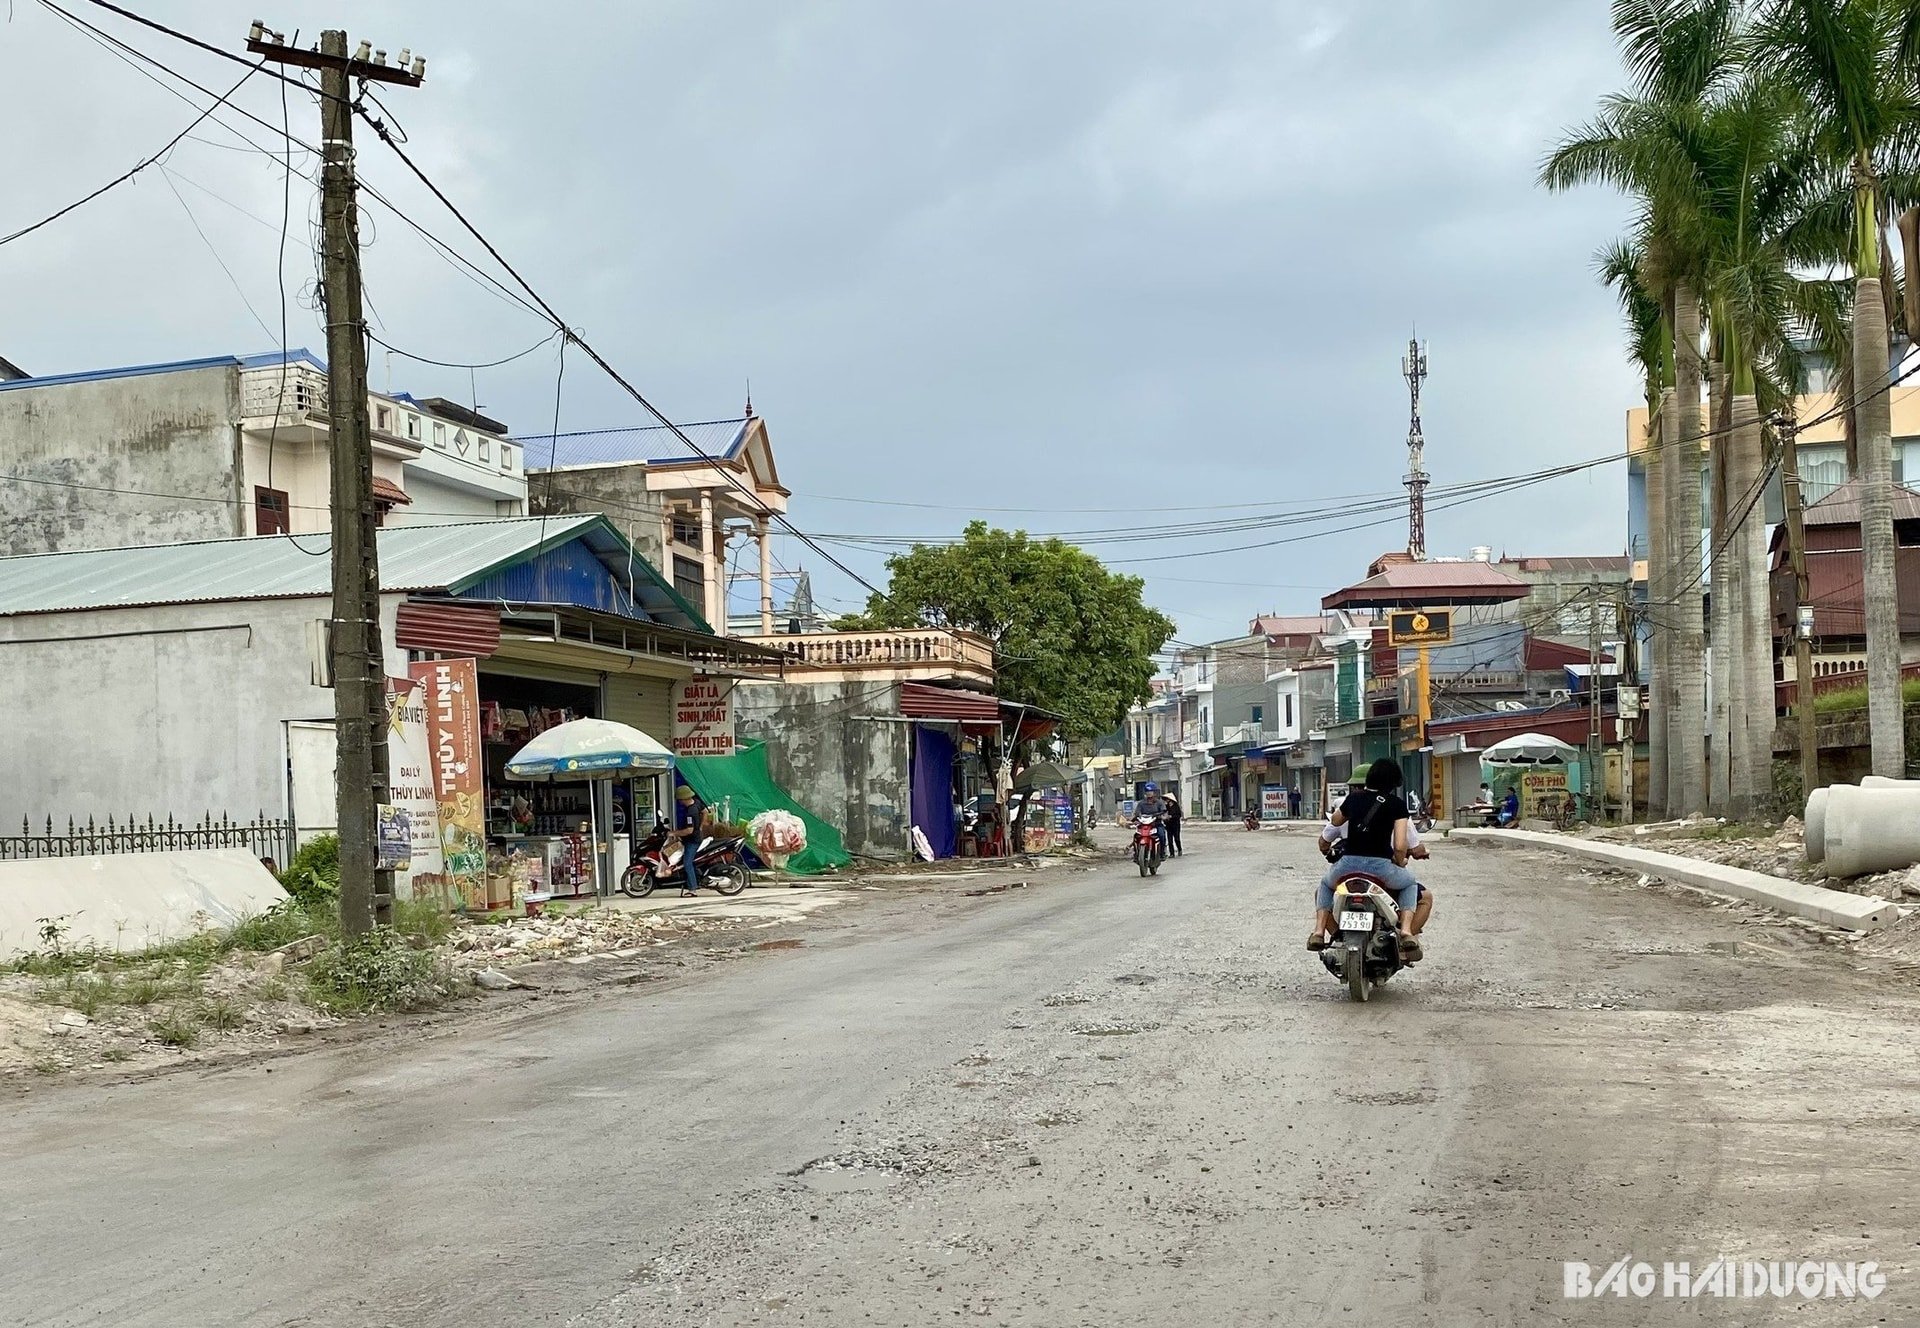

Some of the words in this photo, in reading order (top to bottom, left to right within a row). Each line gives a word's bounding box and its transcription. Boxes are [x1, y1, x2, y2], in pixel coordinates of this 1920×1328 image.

[435, 666, 453, 722] LINH
[707, 684, 719, 697] LÀ
[677, 711, 700, 723] SINH
[436, 728, 456, 795] THÙY
[416, 786, 434, 800] LINH
